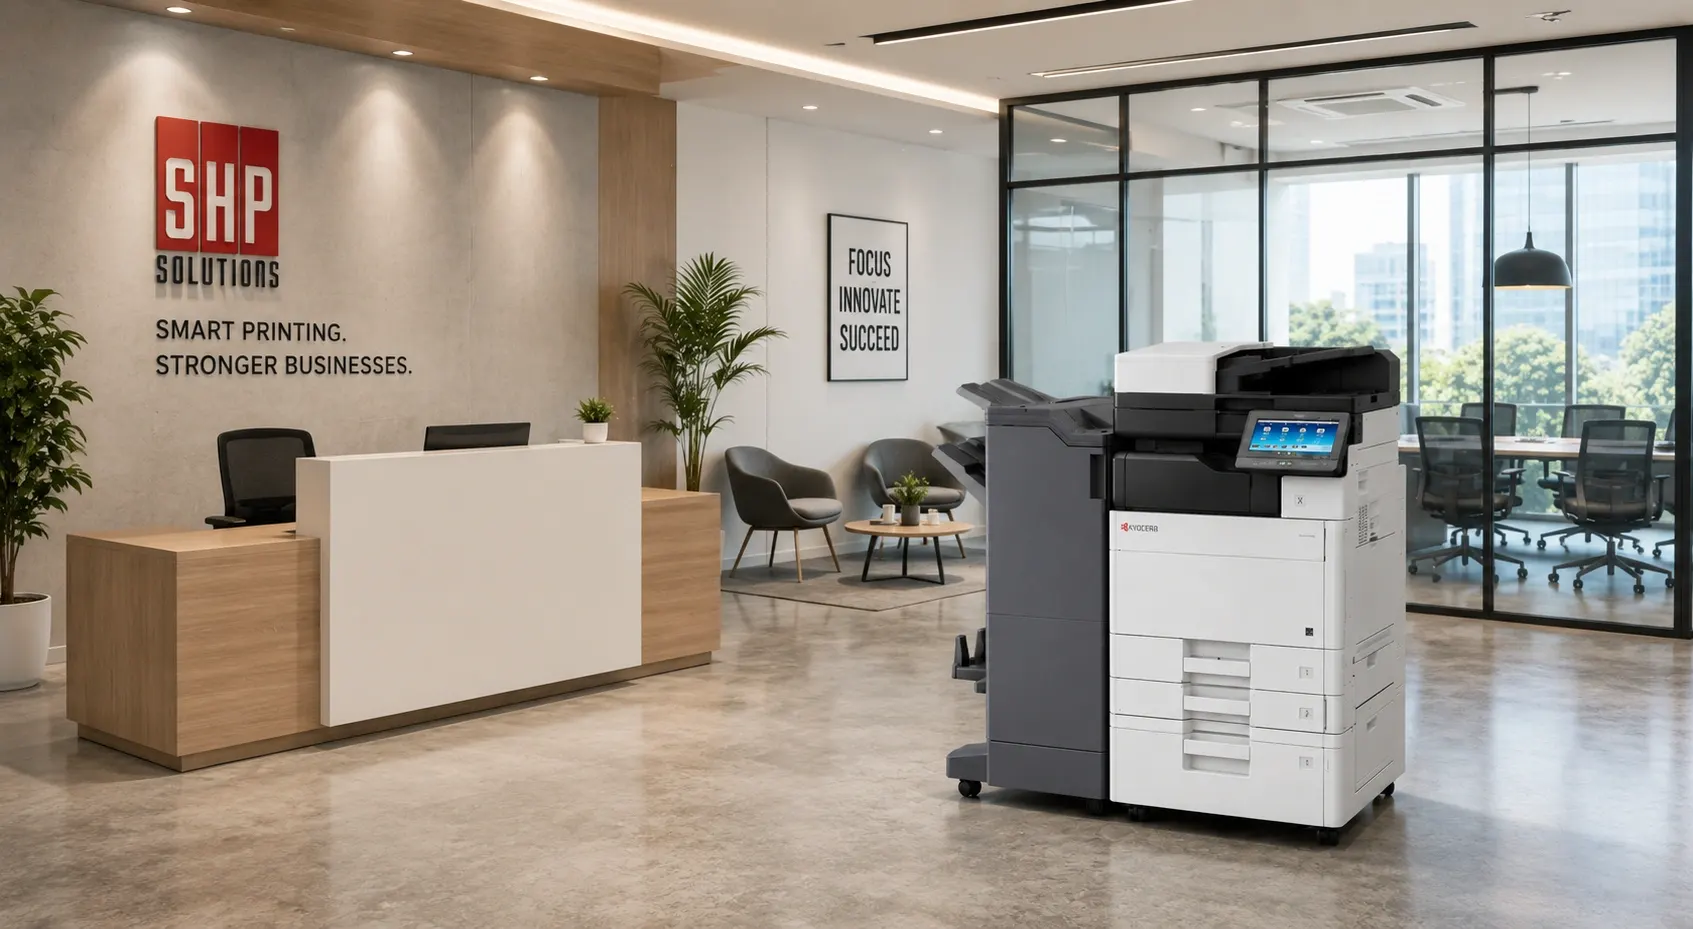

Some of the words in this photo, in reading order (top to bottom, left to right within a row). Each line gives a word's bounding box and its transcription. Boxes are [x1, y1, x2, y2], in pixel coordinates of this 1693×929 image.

[165, 157, 273, 244] SHP
[848, 247, 891, 278] FOCUS
[839, 286, 901, 314] INNOVATE
[156, 319, 234, 341] SMART
[243, 321, 347, 342] PRINTING.
[840, 324, 899, 351] SUCCEED
[156, 354, 278, 375] STRONGER
[286, 355, 413, 375] BUSINESSES.
